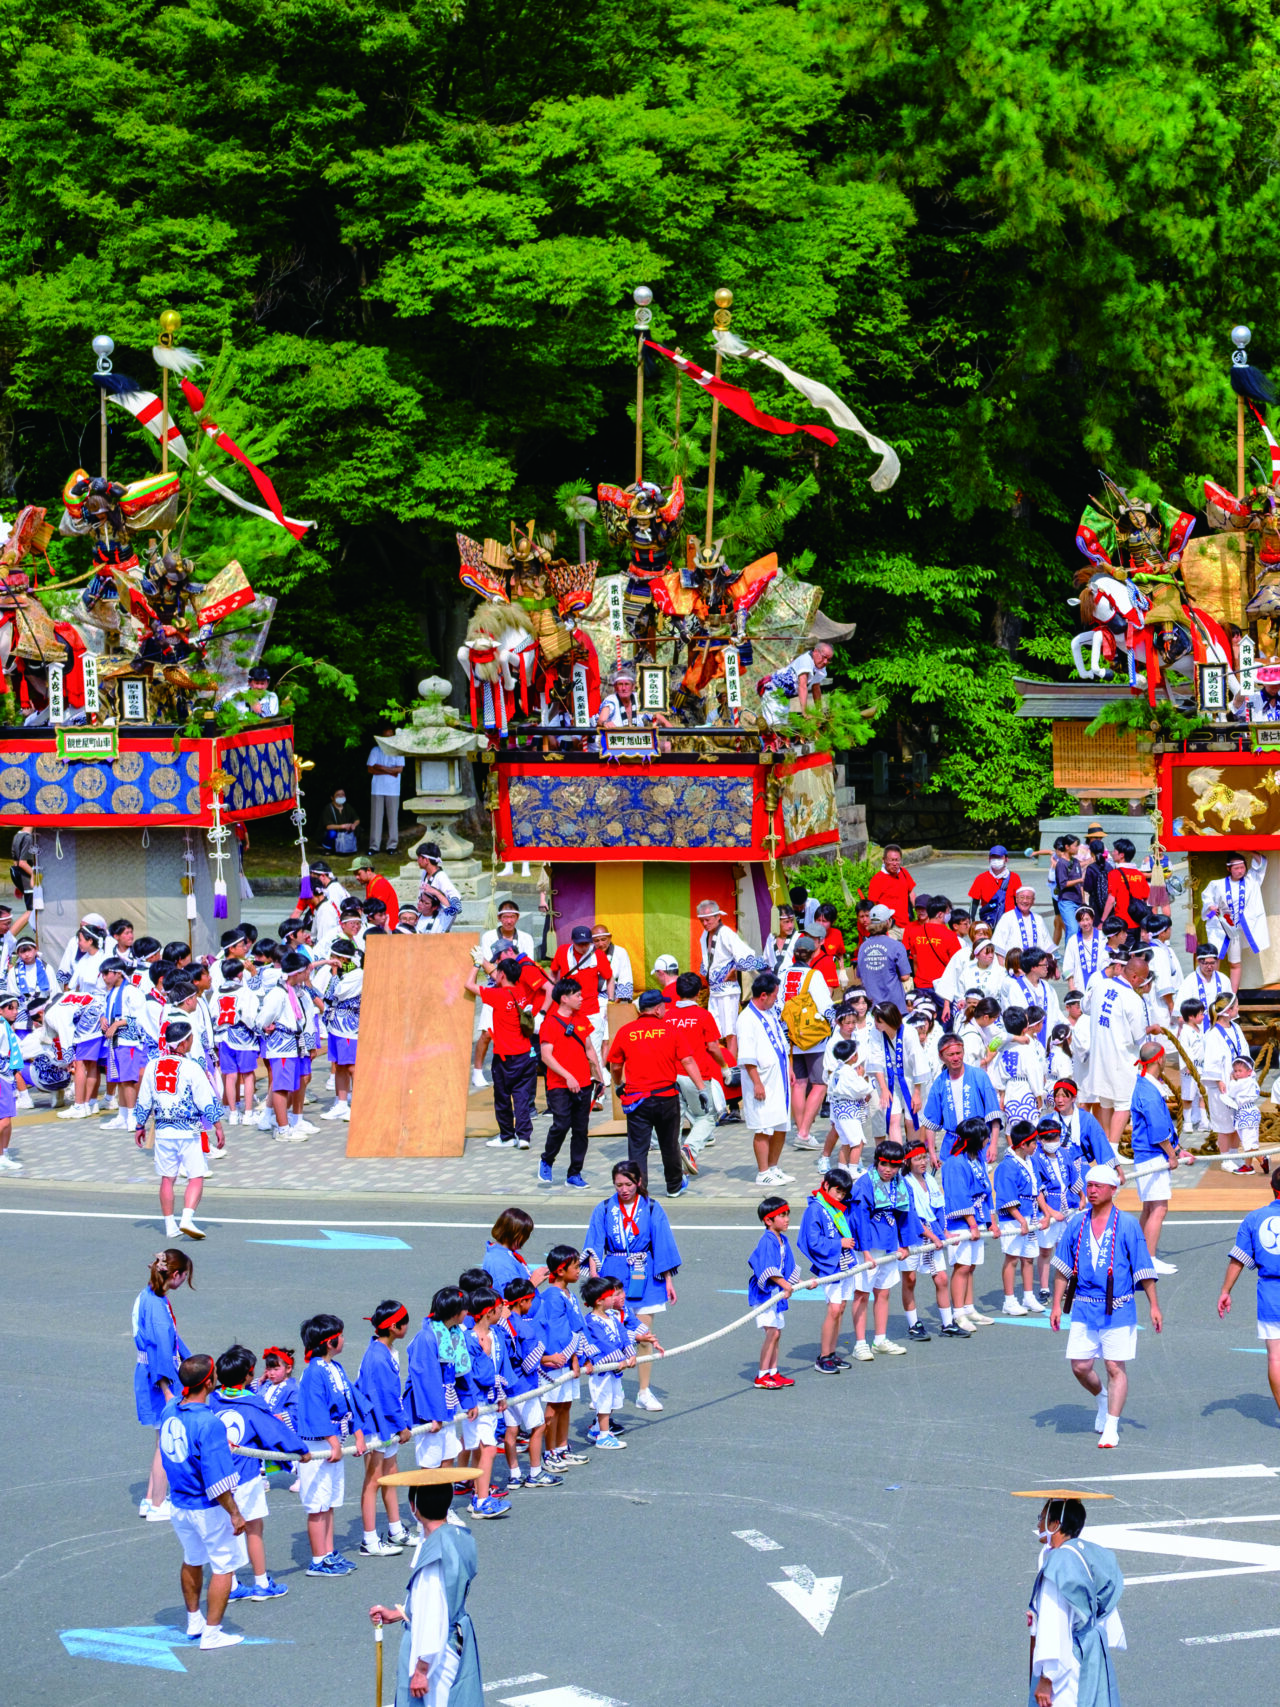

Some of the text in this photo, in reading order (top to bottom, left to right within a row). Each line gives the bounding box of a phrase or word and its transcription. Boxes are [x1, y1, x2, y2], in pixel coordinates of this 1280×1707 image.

[1098, 988, 1119, 1029] 唐仁橋
[629, 1029, 666, 1041] STAFF
